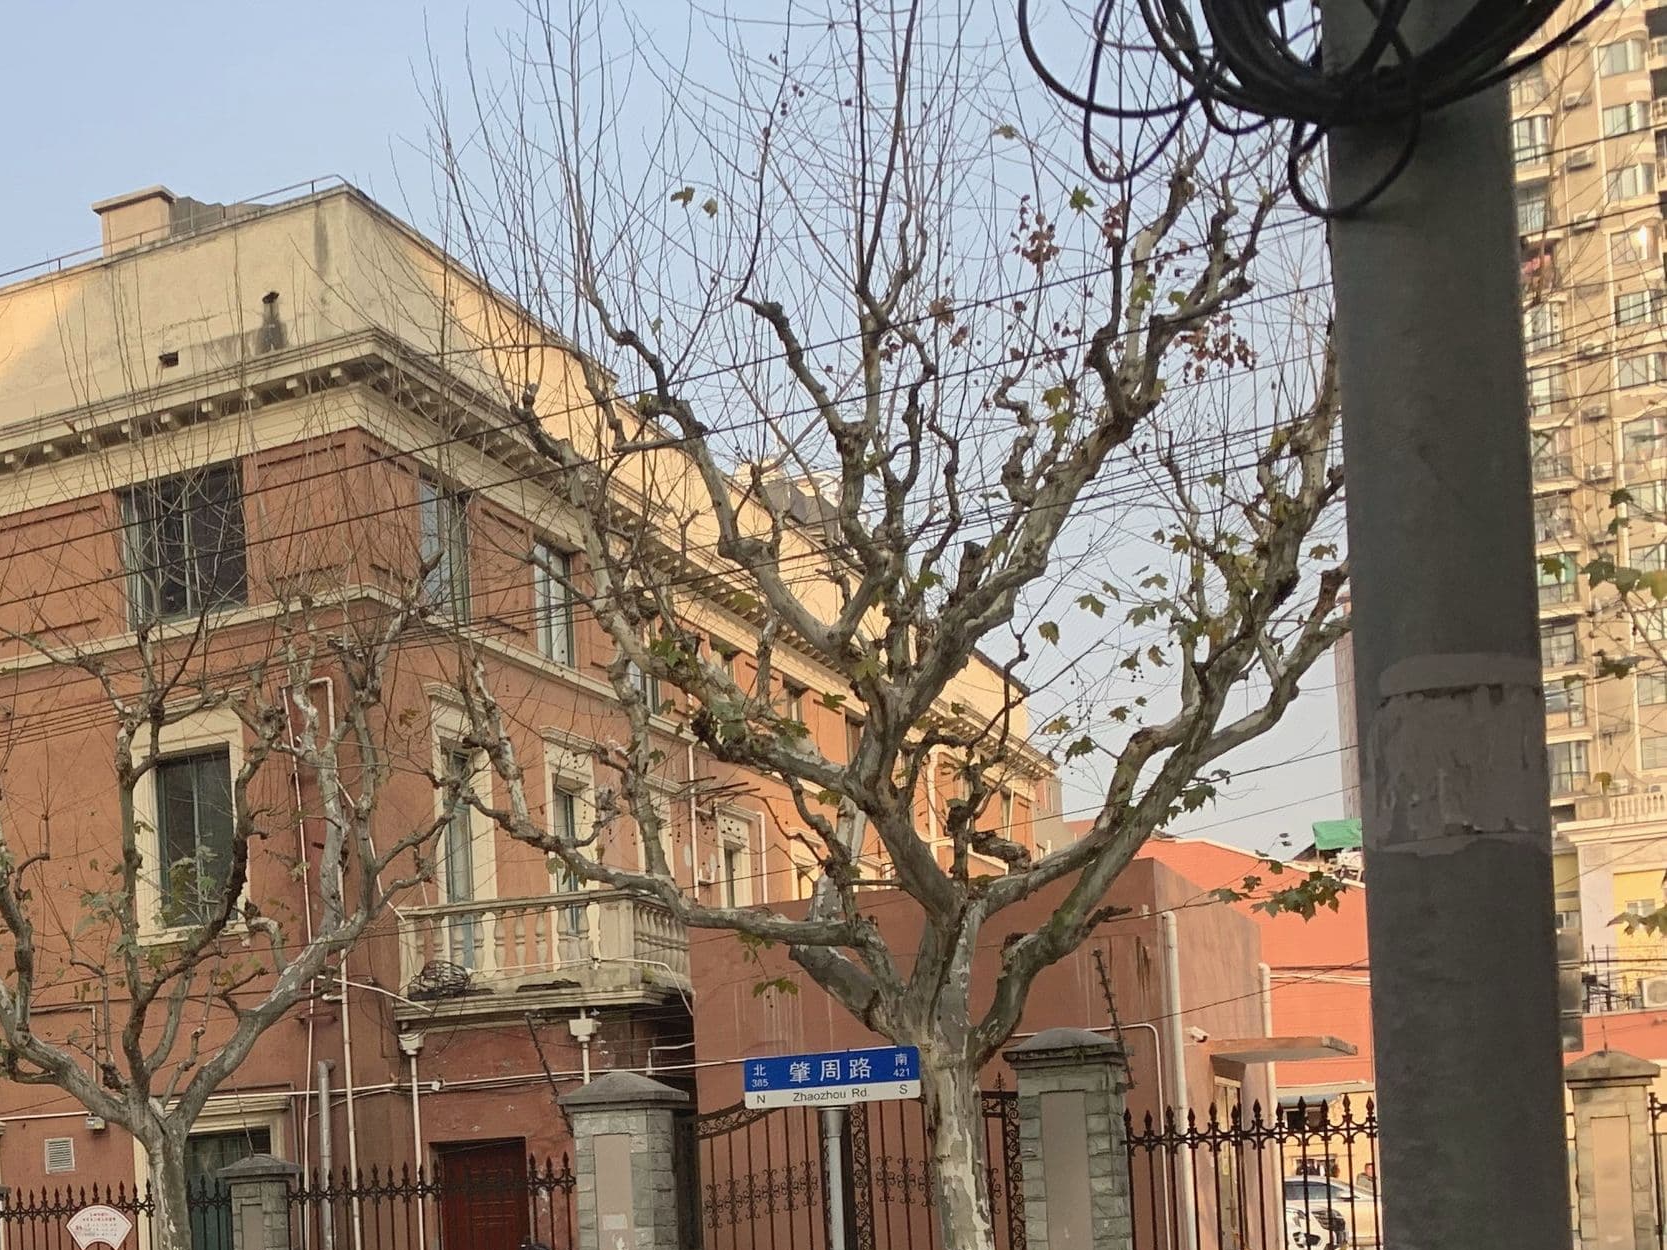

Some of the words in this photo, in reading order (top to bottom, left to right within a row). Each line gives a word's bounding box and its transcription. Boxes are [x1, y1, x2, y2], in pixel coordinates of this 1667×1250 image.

[895, 1053, 908, 1066] 南
[754, 1064, 767, 1076] 北
[789, 1057, 872, 1083] 肇周路
[892, 1068, 910, 1077] 421
[751, 1078, 769, 1088] 385
[899, 1084, 908, 1094] S
[756, 1094, 766, 1104] N
[793, 1091, 847, 1102] Zhaozhou
